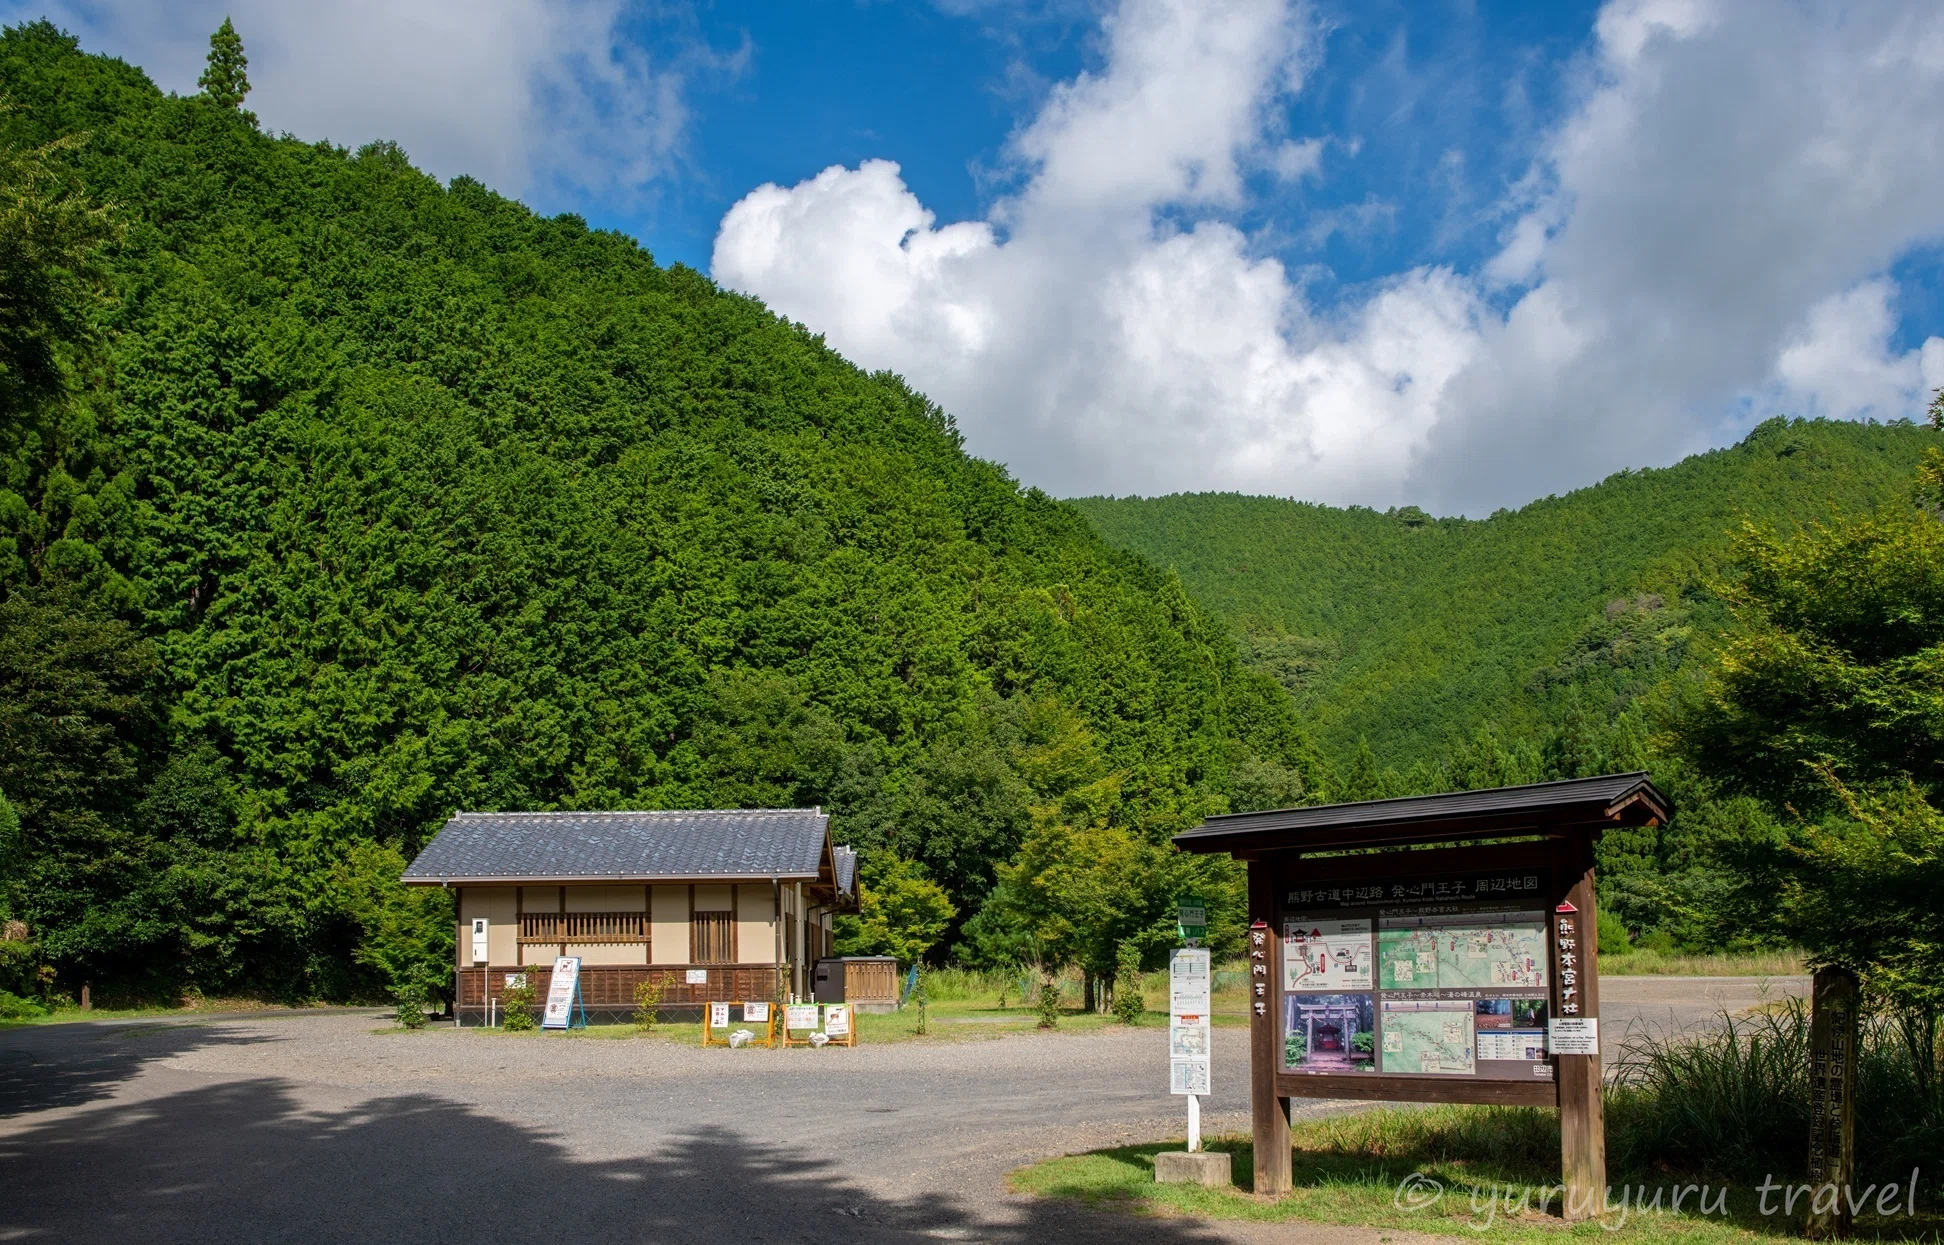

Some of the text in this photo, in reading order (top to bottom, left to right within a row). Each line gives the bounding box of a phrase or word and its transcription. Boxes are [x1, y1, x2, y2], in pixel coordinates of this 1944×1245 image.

[1287, 876, 1538, 904] 熊野古道中辺路 発心門王子 周辺地図
[1252, 932, 1267, 1015] 発心門王子
[1560, 918, 1578, 1014] 熊野本宮大社
